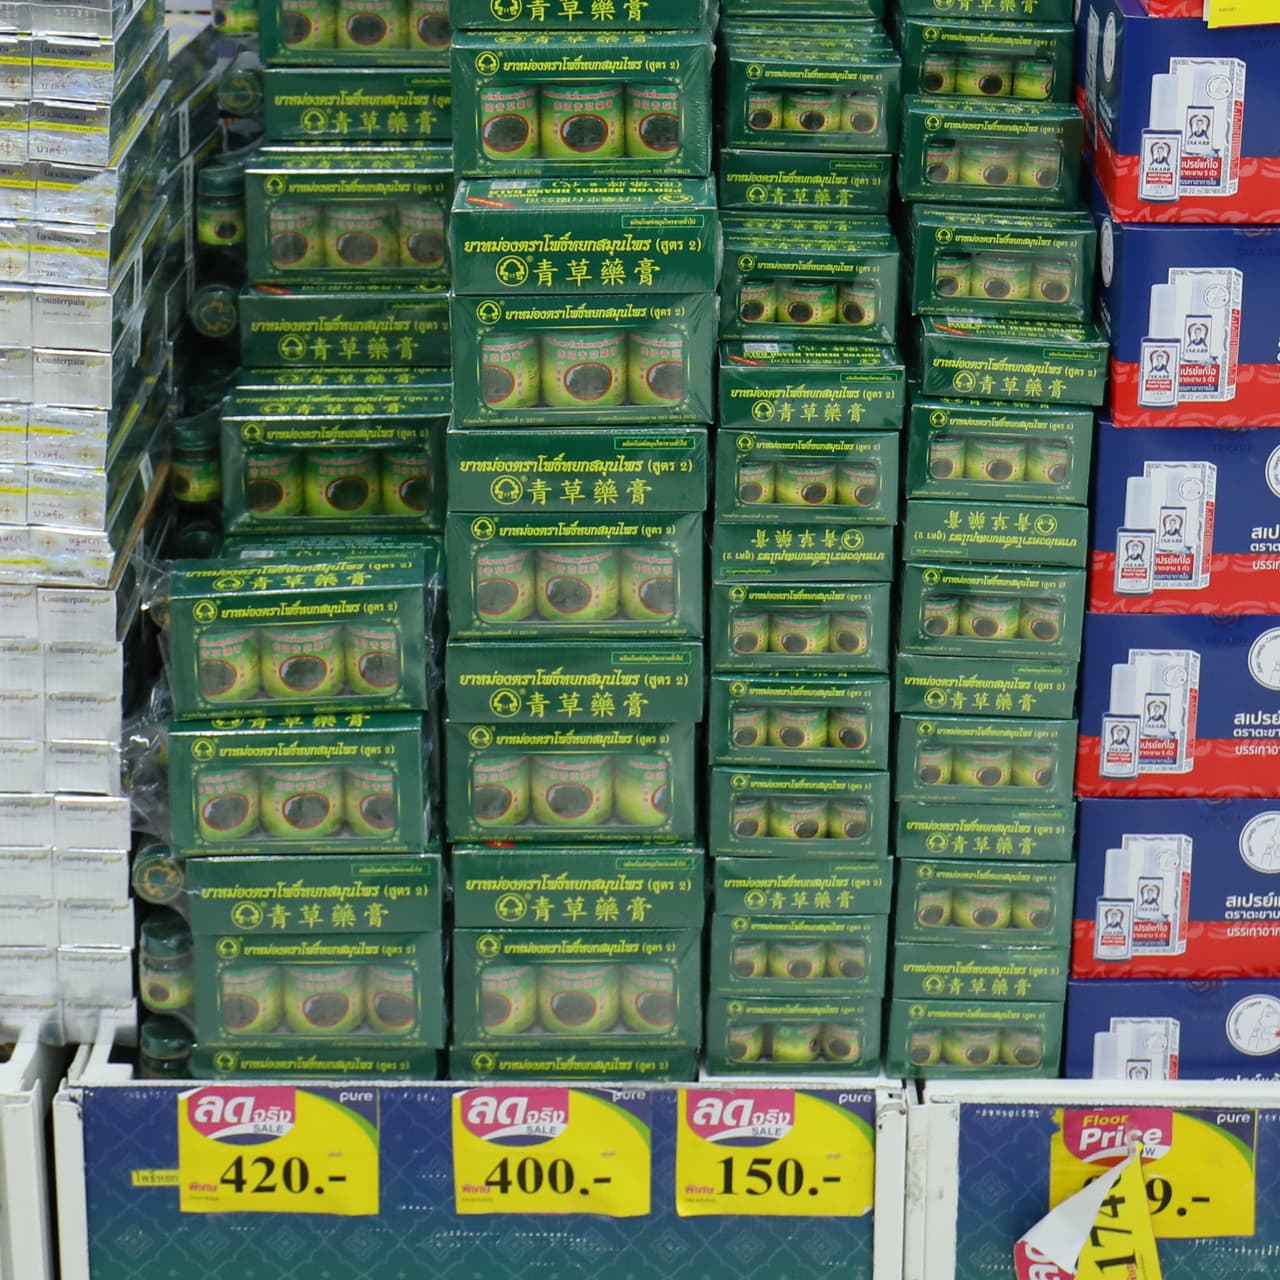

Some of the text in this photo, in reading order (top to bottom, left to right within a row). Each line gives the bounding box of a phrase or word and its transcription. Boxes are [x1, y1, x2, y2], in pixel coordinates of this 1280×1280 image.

[532, 257, 662, 288] 青草藥膏
[778, 400, 867, 423] 青草藥膏
[194, 1094, 293, 1125] ลดจริง
[340, 1091, 373, 1104] pure
[467, 1096, 567, 1127] ลดจริง
[693, 1096, 792, 1127] ลดจริง
[838, 1092, 872, 1105] pure
[252, 1124, 284, 1134] SALE
[221, 1155, 347, 1195] 420.-
[484, 1156, 613, 1197] 400.-
[717, 1156, 842, 1197] 150.-
